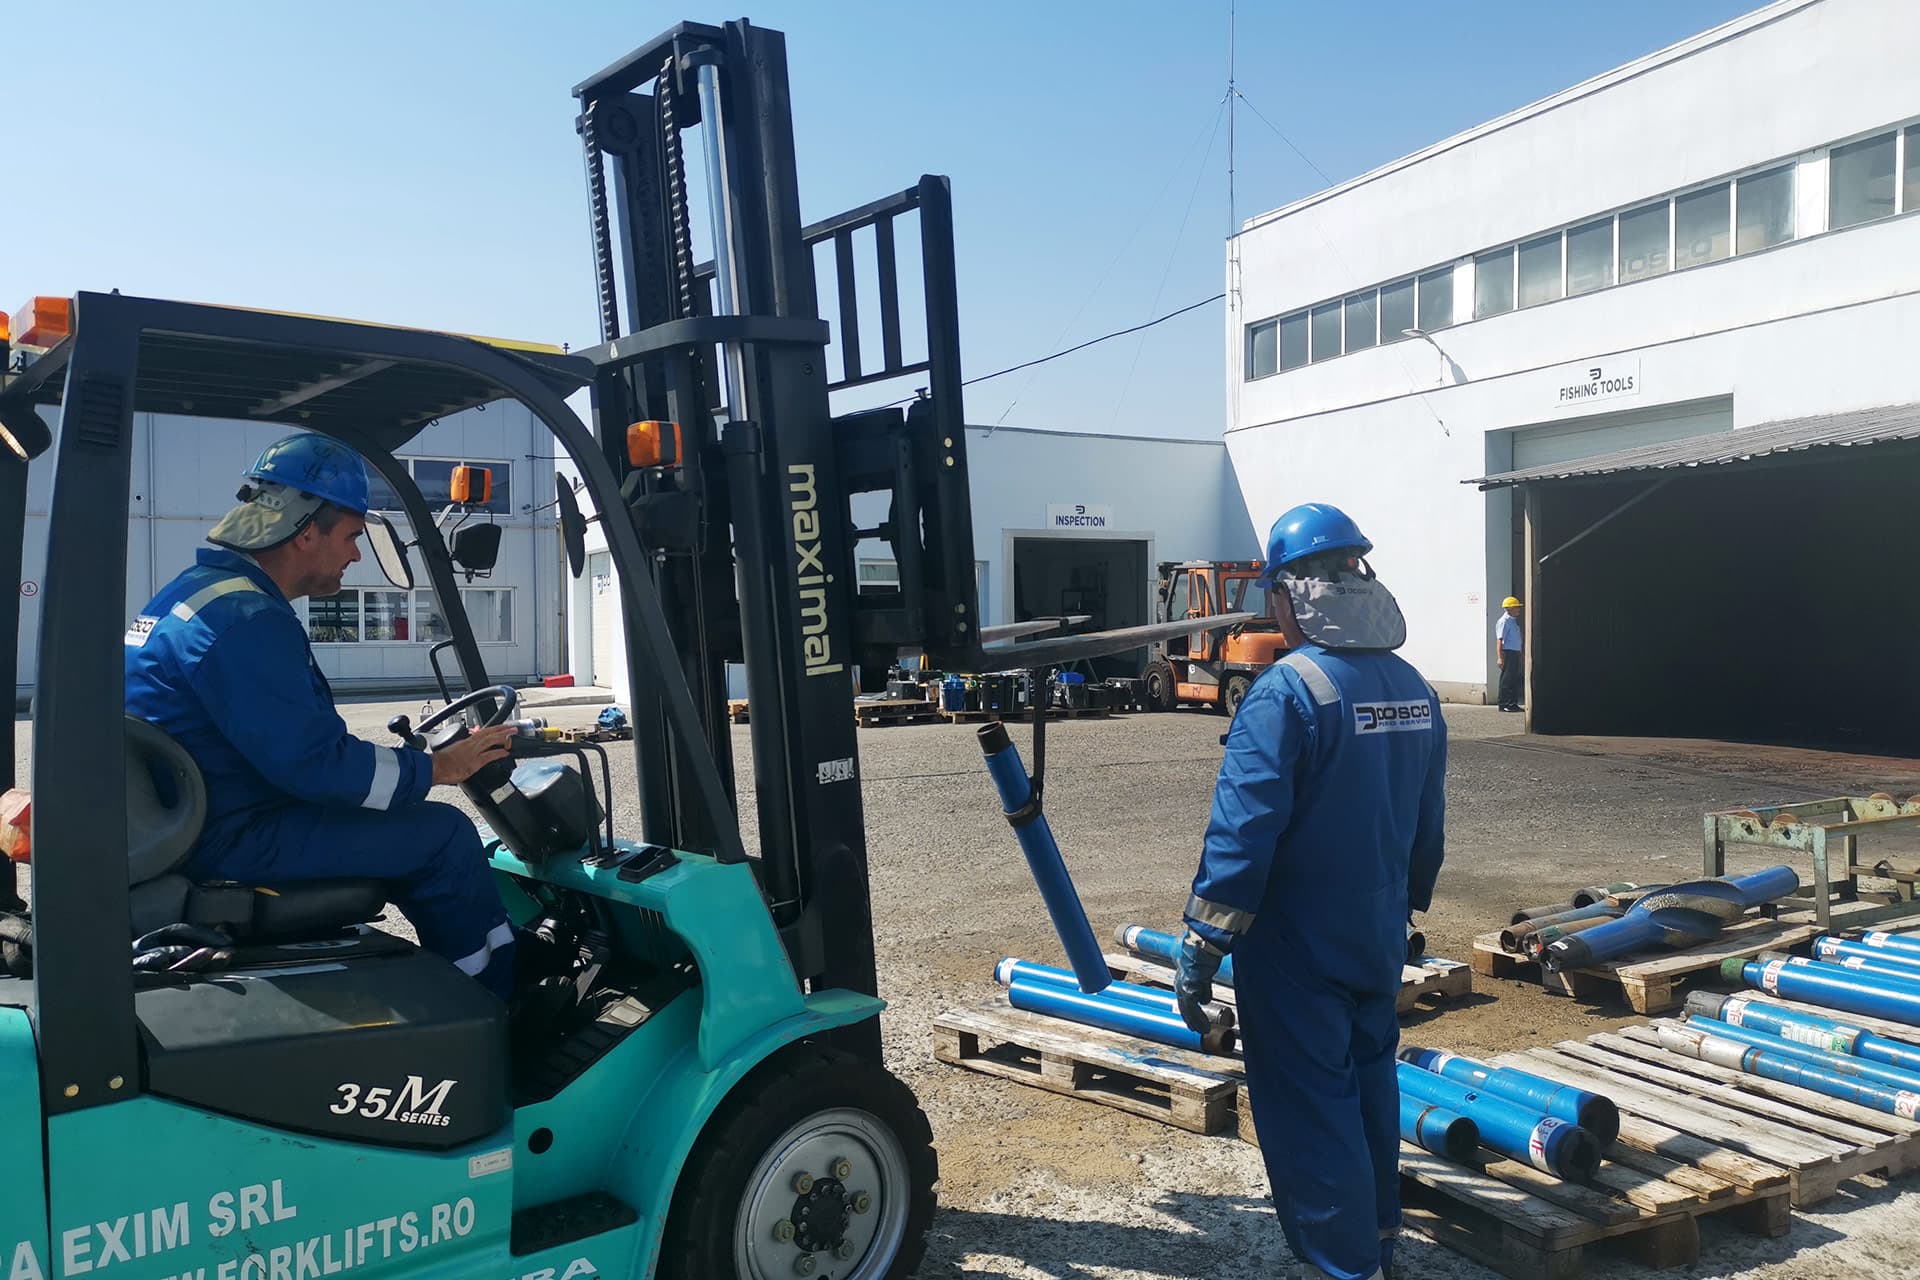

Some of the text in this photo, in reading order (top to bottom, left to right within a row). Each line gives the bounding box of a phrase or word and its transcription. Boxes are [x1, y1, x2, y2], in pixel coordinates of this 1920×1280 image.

[1560, 376, 1633, 401] FISHING TOOLS
[1055, 515, 1105, 527] INSPECTION
[788, 464, 844, 677] maximal
[400, 1111, 451, 1127] SERIES
[0, 1178, 297, 1280] A EXIM SRL
